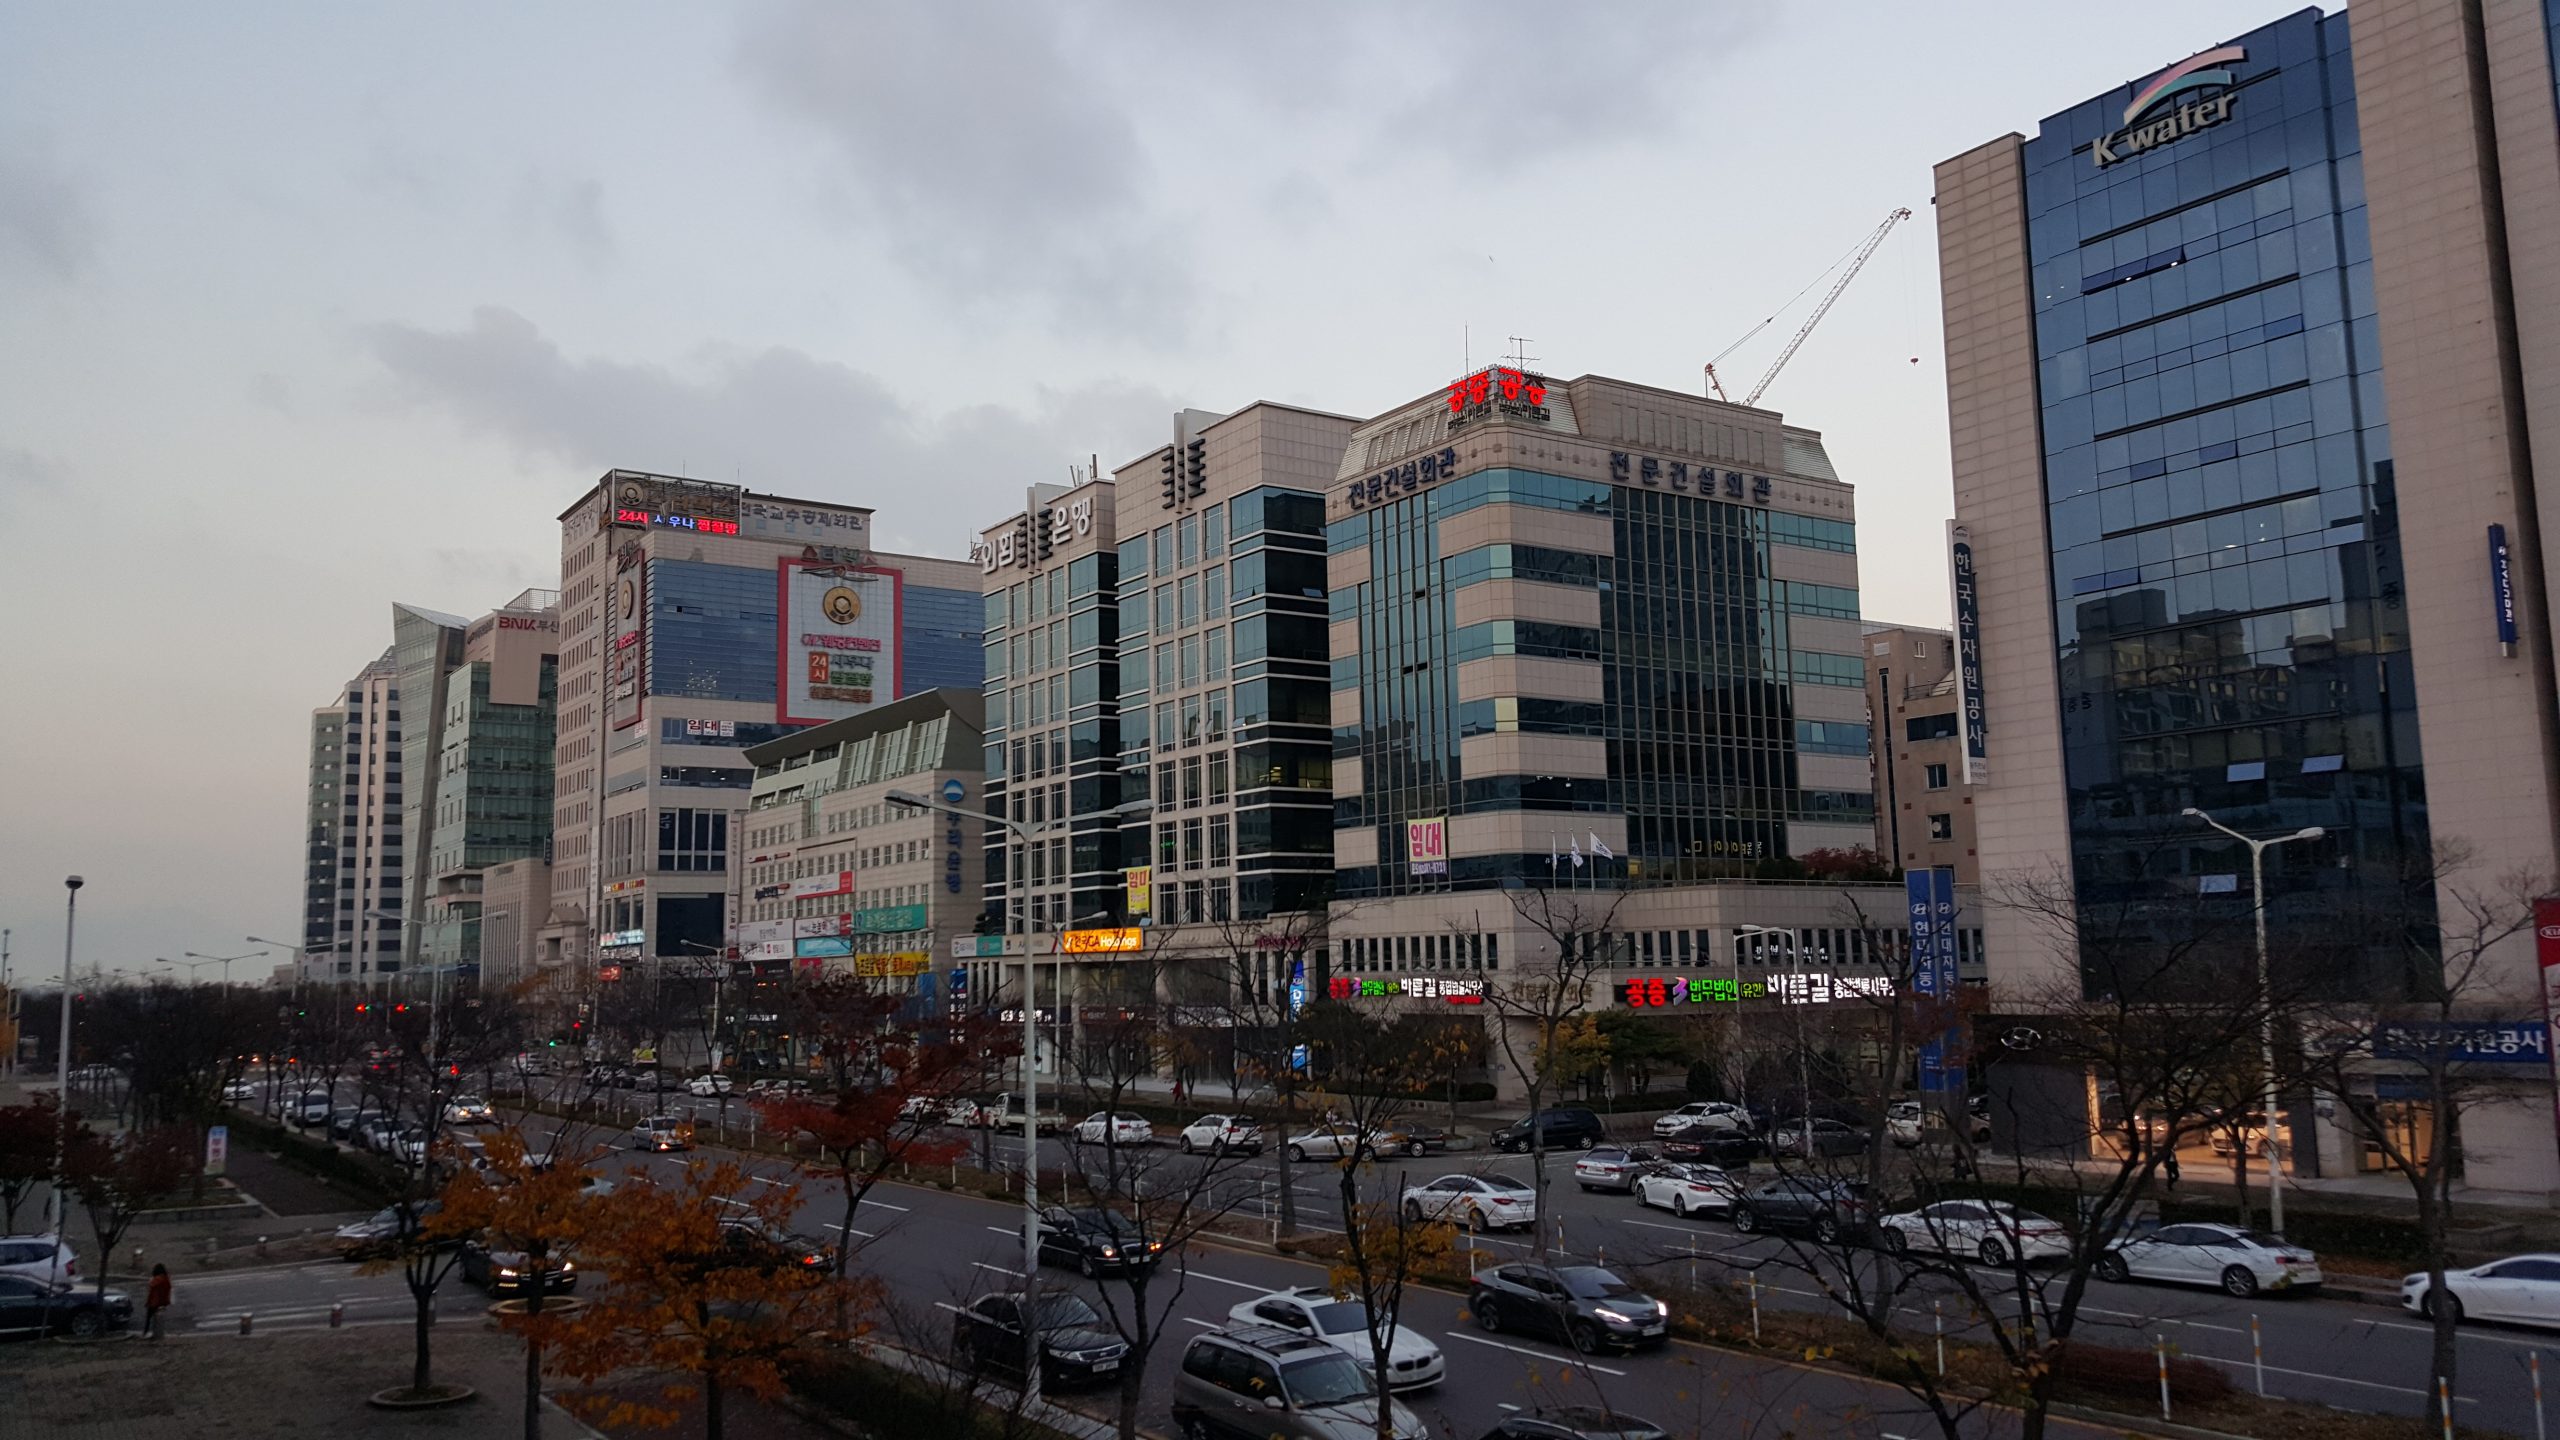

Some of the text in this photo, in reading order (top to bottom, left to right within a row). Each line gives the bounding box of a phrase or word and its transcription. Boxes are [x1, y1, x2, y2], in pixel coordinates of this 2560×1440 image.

[2127, 93, 2236, 151] water
[1447, 371, 1489, 413] 공증
[1498, 367, 1548, 405] 공증
[1348, 446, 1456, 509] 전문건설회관
[1610, 452, 1772, 502] 전문건설회관
[618, 509, 648, 524] 24시
[1053, 497, 1093, 545] 은행
[2500, 559, 2513, 622] HYUNDAI
[499, 616, 536, 631] BNK
[811, 655, 827, 667] 24
[1955, 552, 1983, 748] 한국수자원공사
[814, 669, 826, 681] 시
[688, 719, 719, 731] 임대
[1410, 822, 1442, 857] 임대
[1401, 977, 1437, 998] 바른길
[1626, 978, 1667, 1007] 공증
[1689, 978, 1739, 1003] 법무법인
[1767, 973, 1829, 1005] 바른길
